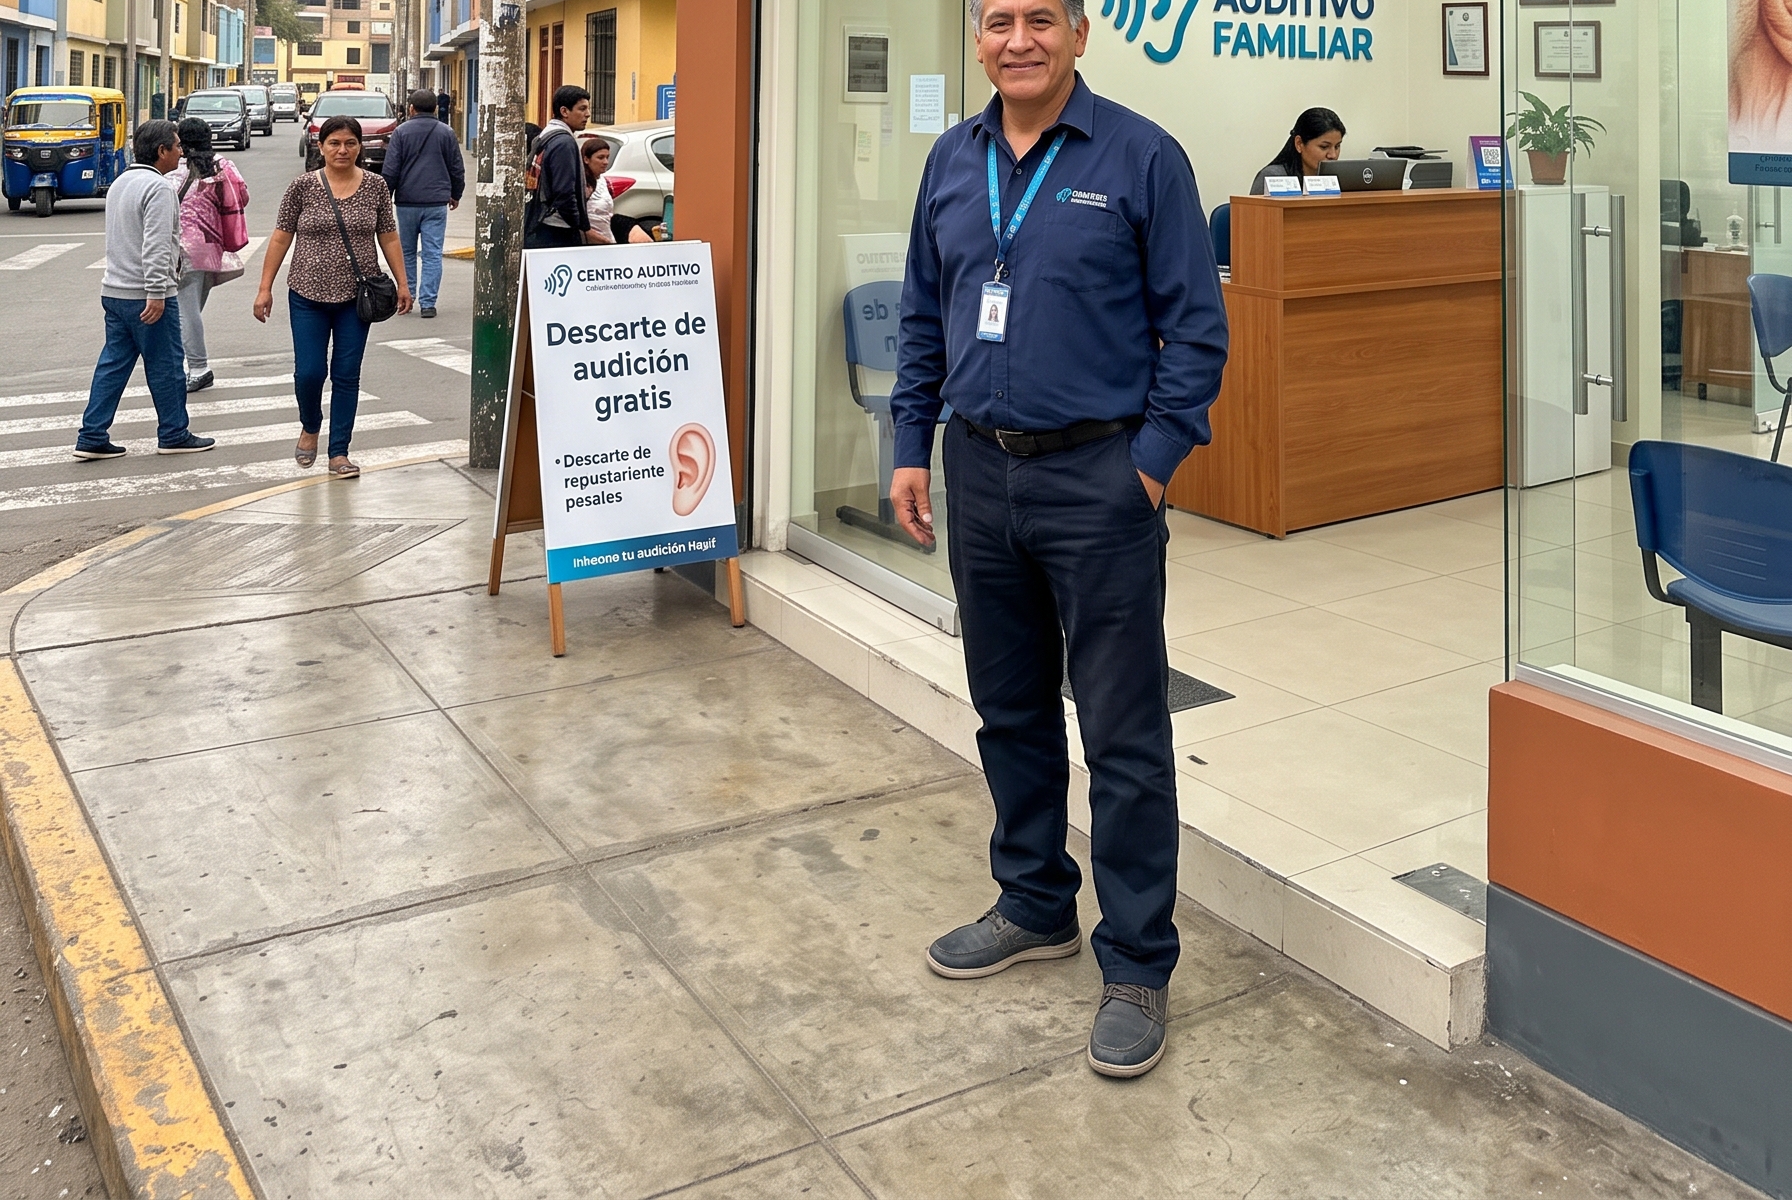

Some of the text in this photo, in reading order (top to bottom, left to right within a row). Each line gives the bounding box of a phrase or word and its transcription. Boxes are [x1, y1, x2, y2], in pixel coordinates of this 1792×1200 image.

[1213, 21, 1373, 62] FAMILIAR
[577, 263, 701, 282] CENTRO AUDITIVO
[546, 311, 707, 347] Descarte de
[573, 348, 690, 381] audición
[595, 385, 672, 422] gratis
[563, 445, 651, 469] Descarte de
[565, 490, 623, 513] pesales
[621, 551, 635, 562] tu
[637, 541, 686, 559] audición
